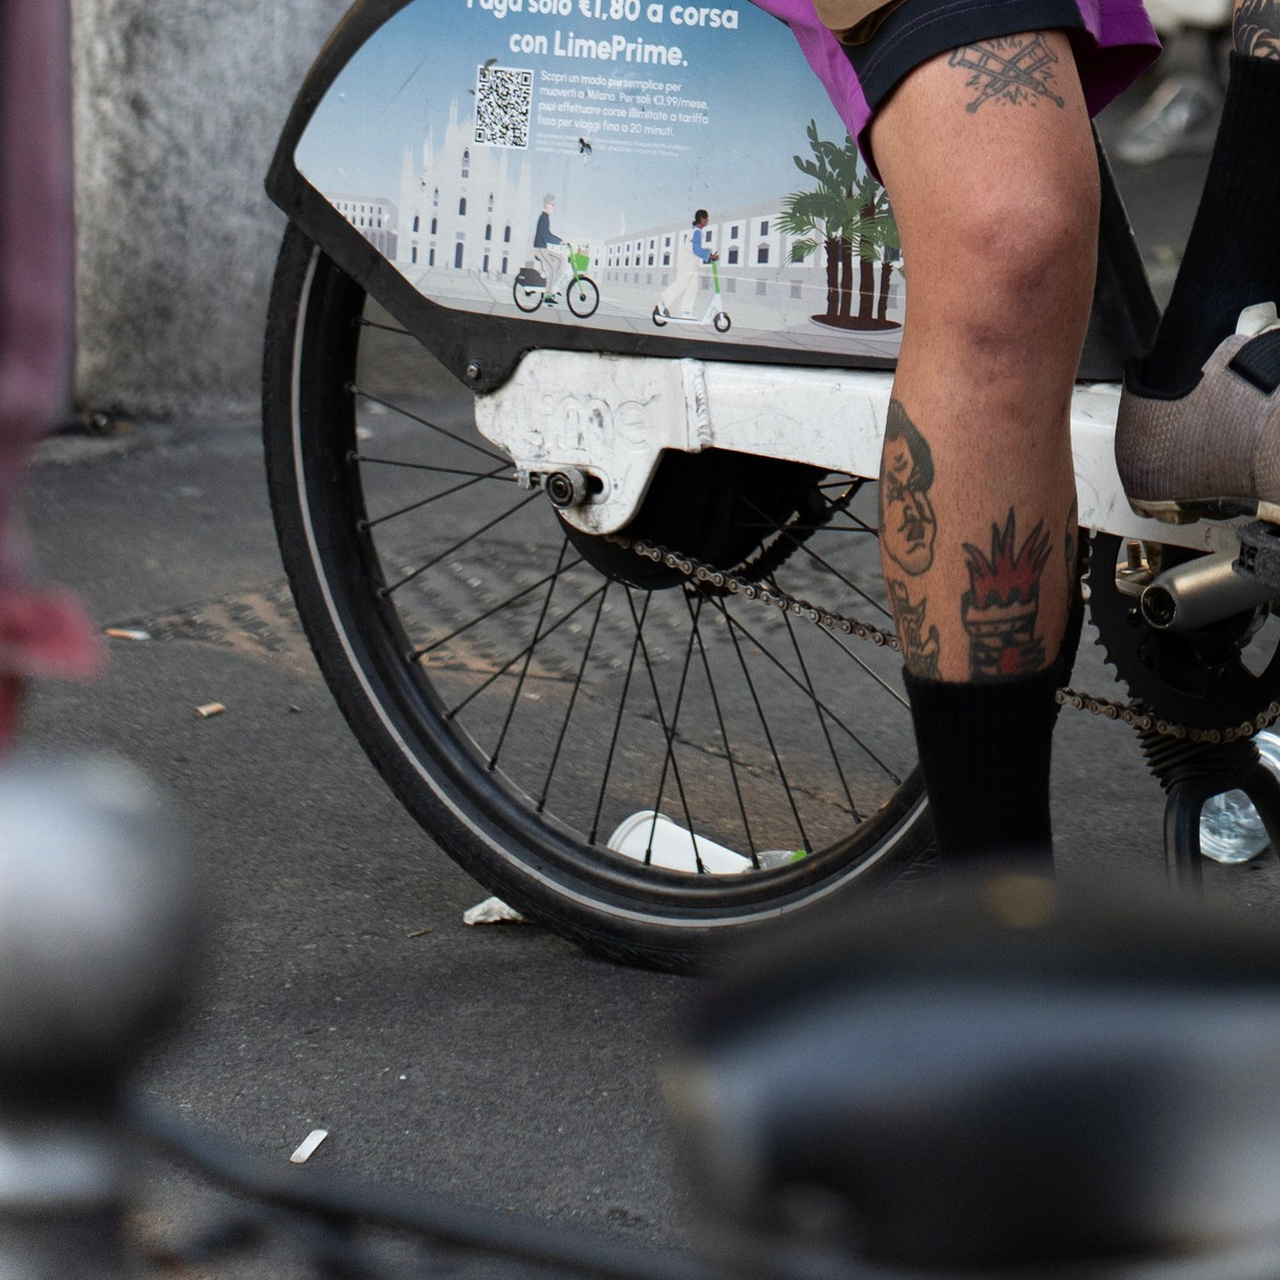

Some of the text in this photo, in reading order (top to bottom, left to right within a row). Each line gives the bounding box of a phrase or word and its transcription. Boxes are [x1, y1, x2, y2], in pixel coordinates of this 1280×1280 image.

[647, 3, 664, 23] a
[670, 5, 738, 29] corsa
[510, 30, 688, 67] con LimePrime.
[541, 70, 568, 85] Scopri
[569, 75, 580, 83] un
[581, 75, 607, 86] modo
[624, 79, 664, 92] semplice
[665, 83, 682, 94] per
[540, 87, 577, 98] muoverti
[578, 90, 585, 99] a
[620, 92, 633, 103] Per
[636, 93, 651, 105] soli
[539, 101, 709, 124] puoi effettuare corse illimitate a tariffa
[538, 114, 674, 137] fissa per viaggi fino a 20 minuti.
